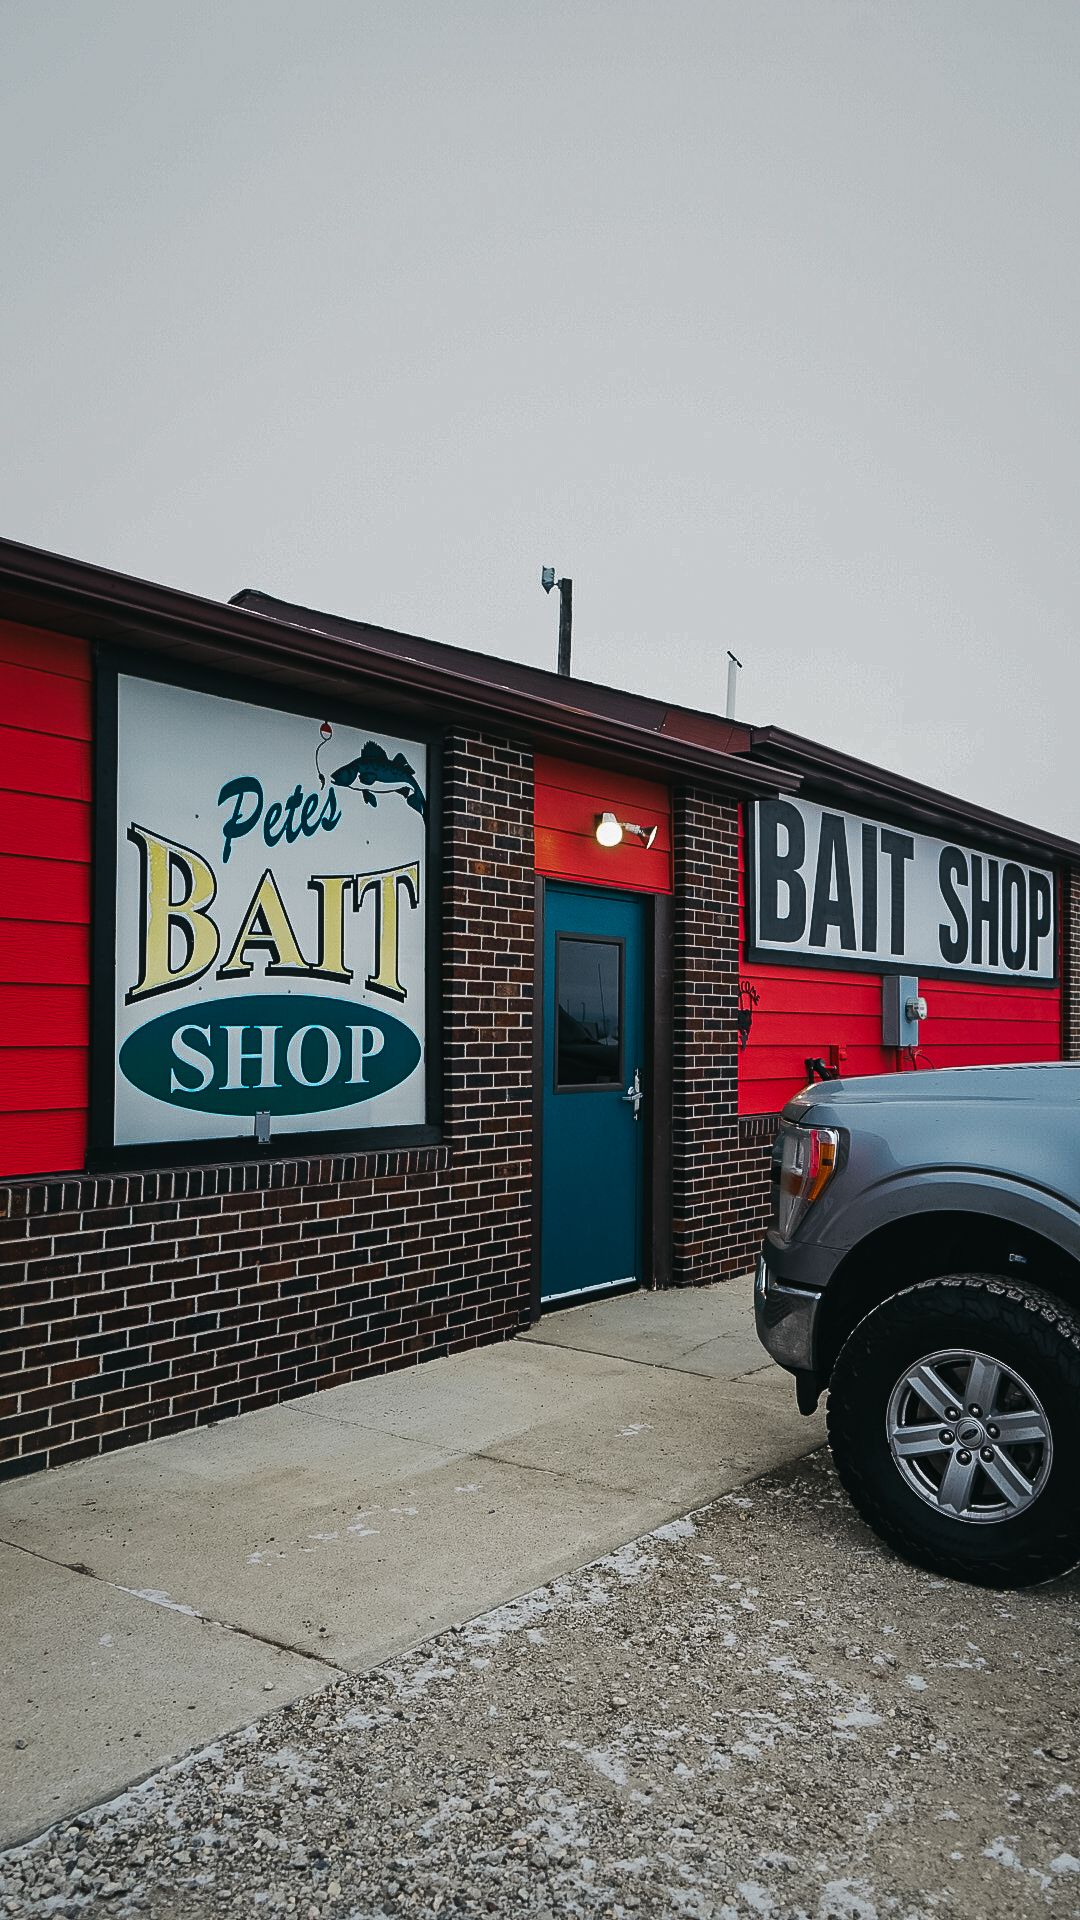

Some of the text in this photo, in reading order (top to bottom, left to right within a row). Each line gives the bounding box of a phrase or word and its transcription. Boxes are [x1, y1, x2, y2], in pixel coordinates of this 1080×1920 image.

[125, 821, 420, 1005] BAIT
[758, 799, 1052, 972] BAIT SHOP
[170, 1024, 385, 1094] SHOP
